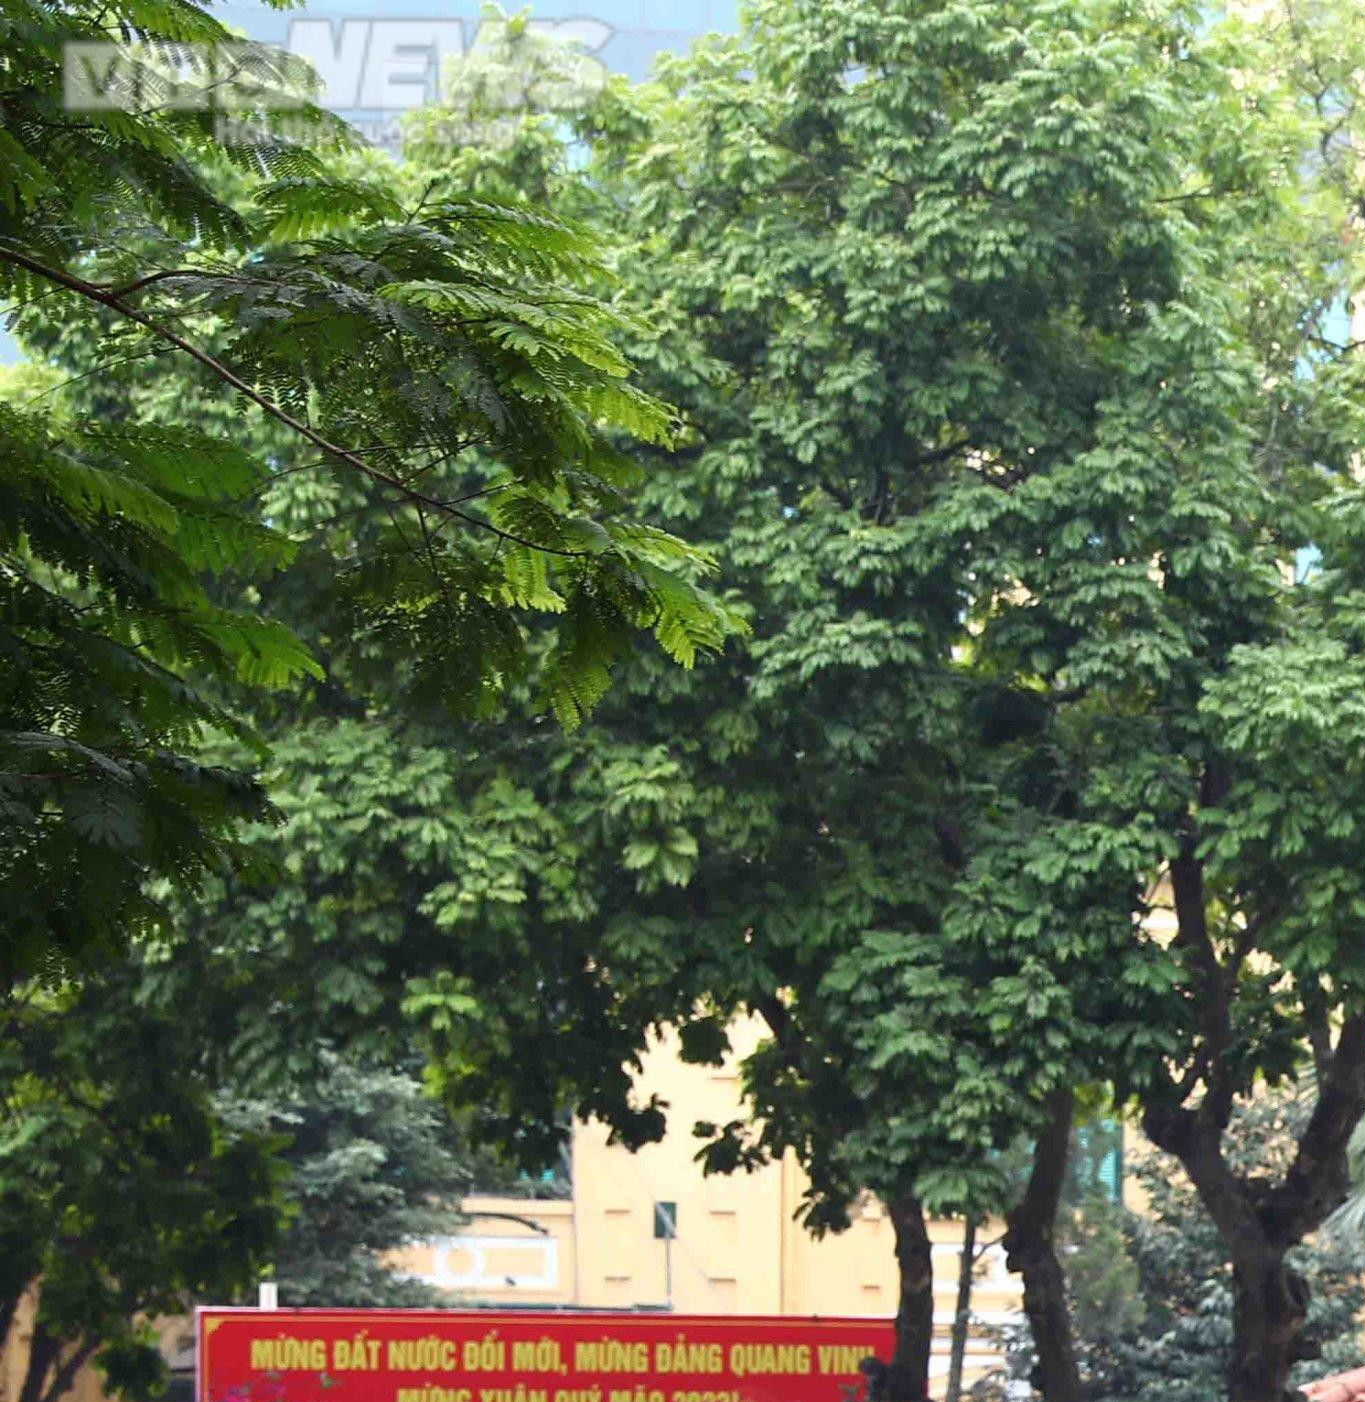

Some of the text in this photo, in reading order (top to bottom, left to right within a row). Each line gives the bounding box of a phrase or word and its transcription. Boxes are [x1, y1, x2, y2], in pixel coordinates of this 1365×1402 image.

[251, 1333, 327, 1370] MỪNG
[388, 1334, 457, 1372] NƯỚC
[575, 1336, 648, 1373] MỪNG
[656, 1333, 724, 1374] ĐẢNG
[730, 1344, 811, 1376] QUANG
